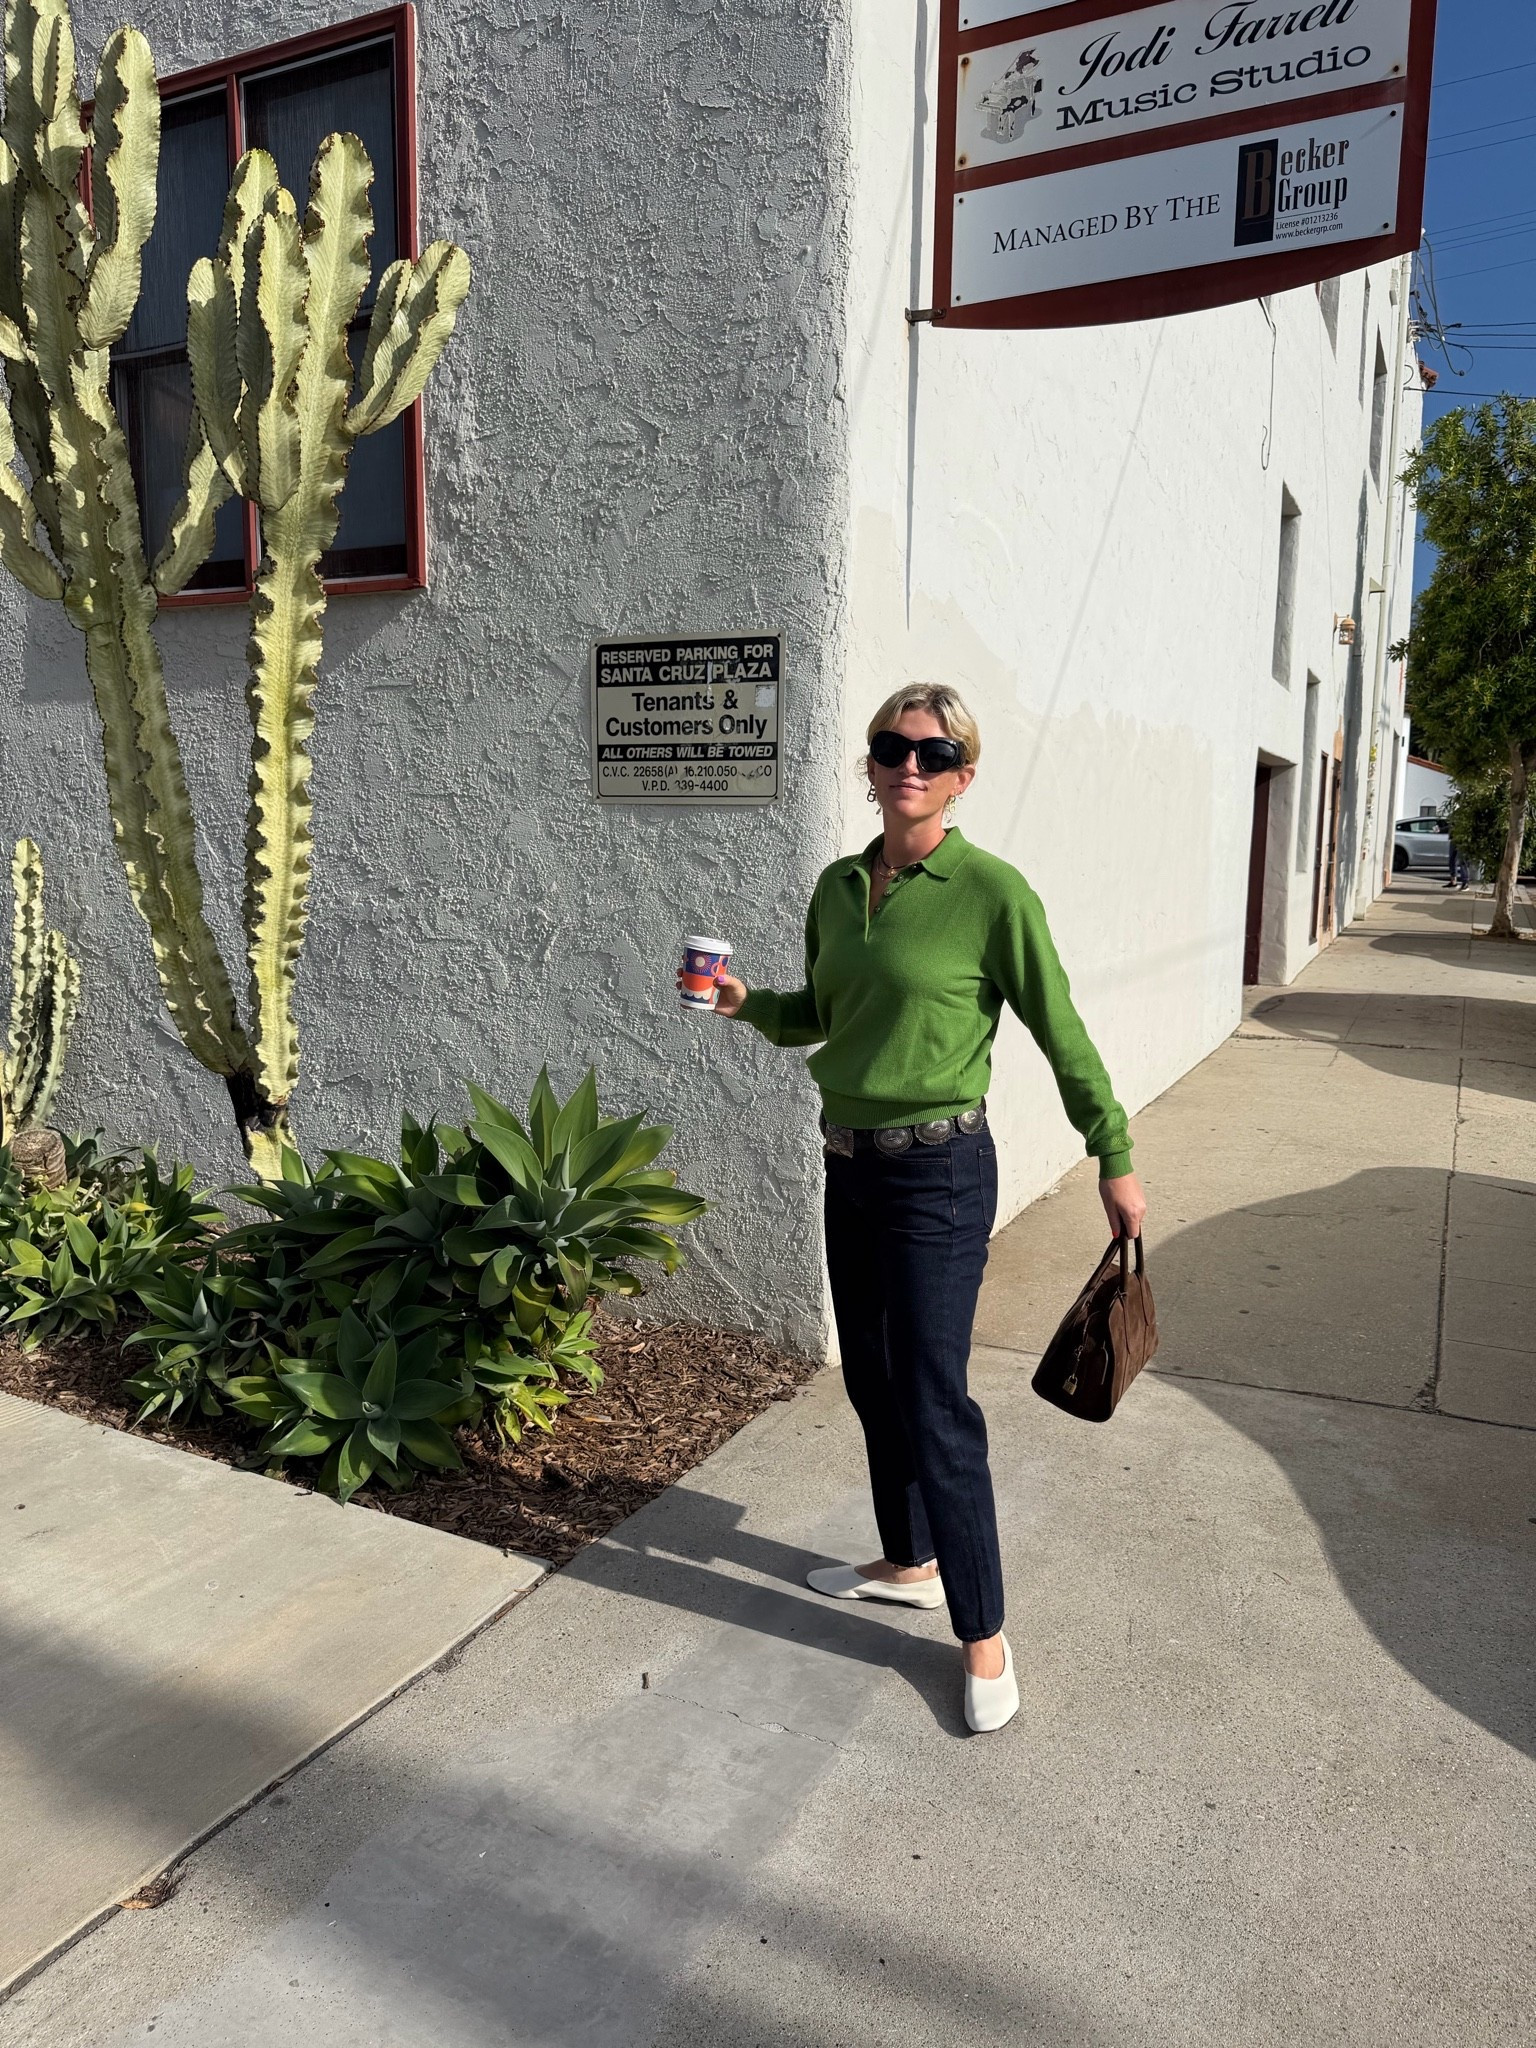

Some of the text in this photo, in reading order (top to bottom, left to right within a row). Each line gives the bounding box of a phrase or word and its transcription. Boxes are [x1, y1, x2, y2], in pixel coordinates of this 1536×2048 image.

[1058, 0, 1359, 96] Jodi Farrell
[1056, 46, 1371, 130] Music Studio
[1278, 177, 1348, 213] Group
[992, 193, 1221, 254] MANAGED BY THE
[1275, 222, 1343, 240] www.beckergrp.com
[1276, 212, 1339, 231] License #01213236
[601, 644, 774, 665] RESERVED PARKING FOR
[600, 662, 772, 684] SANTA CRUZ PLAZA
[632, 689, 738, 712] Tenants &
[605, 714, 768, 739] Customers Only
[602, 745, 773, 759] ALL OTHERS WILL BE TOWED
[602, 766, 630, 778] C.V.C.
[642, 780, 670, 791] V.P.D.
